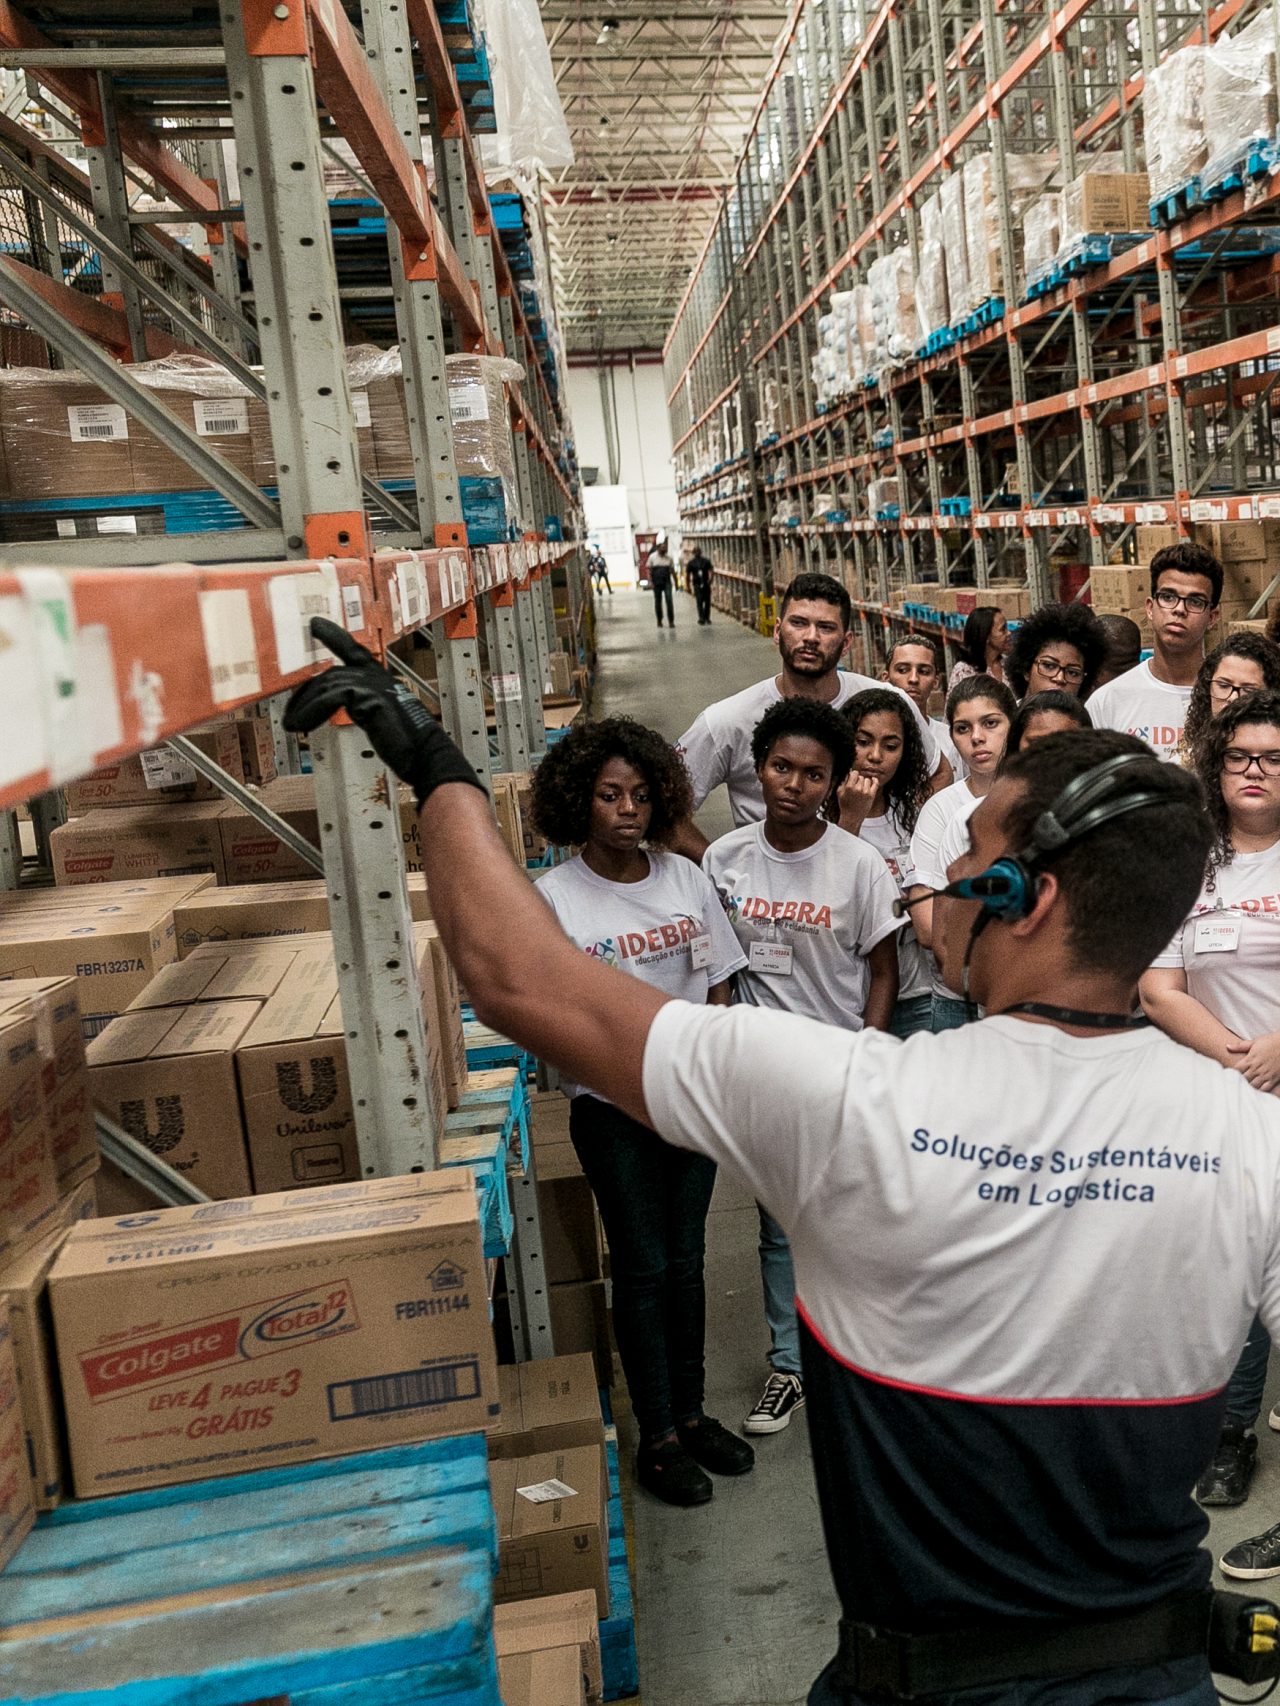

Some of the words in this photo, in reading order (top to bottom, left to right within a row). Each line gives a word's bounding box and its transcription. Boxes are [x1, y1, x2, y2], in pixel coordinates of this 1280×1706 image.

[234, 844, 275, 855] Colgate
[66, 859, 111, 872] Colgate
[742, 897, 832, 930] IDEBRA
[616, 919, 696, 960] IDEBR
[76, 960, 145, 977] FBR13237A
[276, 1114, 352, 1138] Unilever
[910, 1128, 1044, 1173] Soluções
[1050, 1146, 1221, 1175] Sustentáveis
[978, 1181, 1020, 1204] em
[395, 1294, 471, 1321] FBR11144
[98, 1330, 222, 1380] Colgate
[149, 1391, 190, 1412] LEVE
[190, 1382, 212, 1410] 4
[220, 1377, 281, 1400] PAGUE
[281, 1368, 303, 1398] 3
[185, 1405, 275, 1439] GRÁTIS
